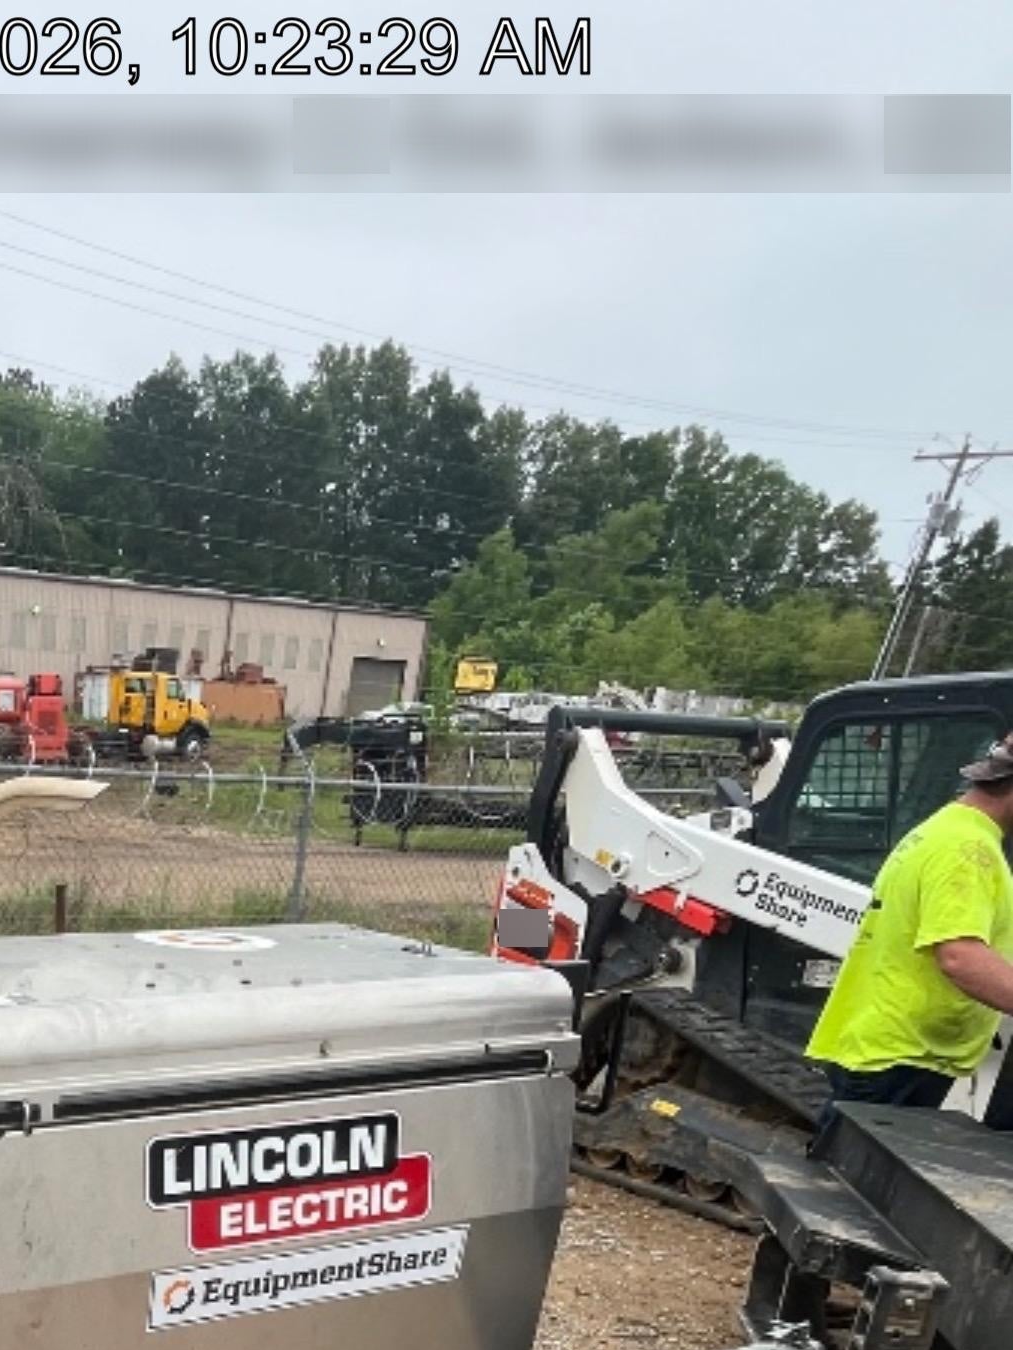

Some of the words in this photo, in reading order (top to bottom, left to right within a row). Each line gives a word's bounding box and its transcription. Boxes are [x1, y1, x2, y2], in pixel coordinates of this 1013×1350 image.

[755, 893, 807, 927] Share
[162, 1124, 387, 1195] LINCOLN
[219, 1180, 408, 1238] ELECTRIC
[200, 1245, 447, 1306] EquipmentShare
